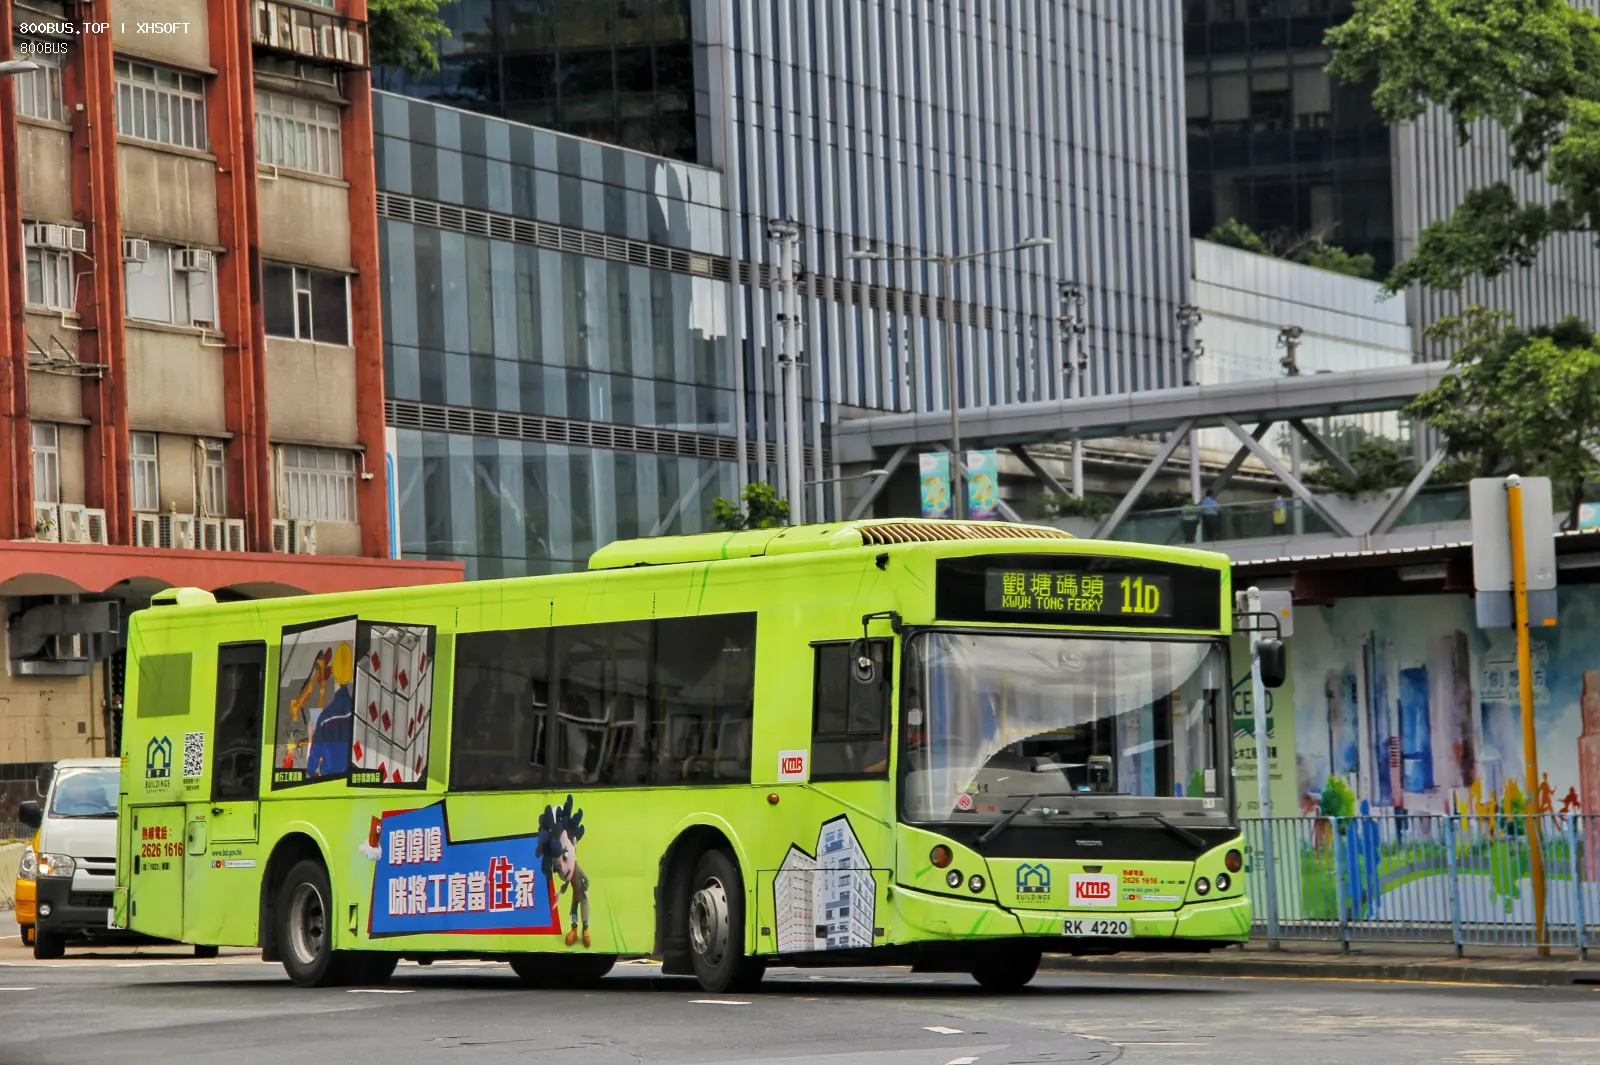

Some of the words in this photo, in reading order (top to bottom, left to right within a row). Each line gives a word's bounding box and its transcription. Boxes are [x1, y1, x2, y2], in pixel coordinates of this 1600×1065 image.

[1002, 572, 1104, 598] 觀塘碼頭
[1002, 595, 1031, 609] KWUN
[1036, 598, 1064, 610] TONG
[1067, 598, 1103, 612] FERRY
[1120, 576, 1160, 614] 11D
[1233, 690, 1274, 715] CED
[781, 757, 803, 774] KMB
[145, 780, 170, 789] BUILDINGS
[141, 843, 162, 858] 2626
[164, 842, 184, 857] 1616
[388, 856, 535, 915] 咪將工廈當住家
[1122, 876, 1140, 884] 2626
[1075, 881, 1111, 899] KMB
[1063, 920, 1084, 934] RK
[1091, 921, 1128, 935] 4220
